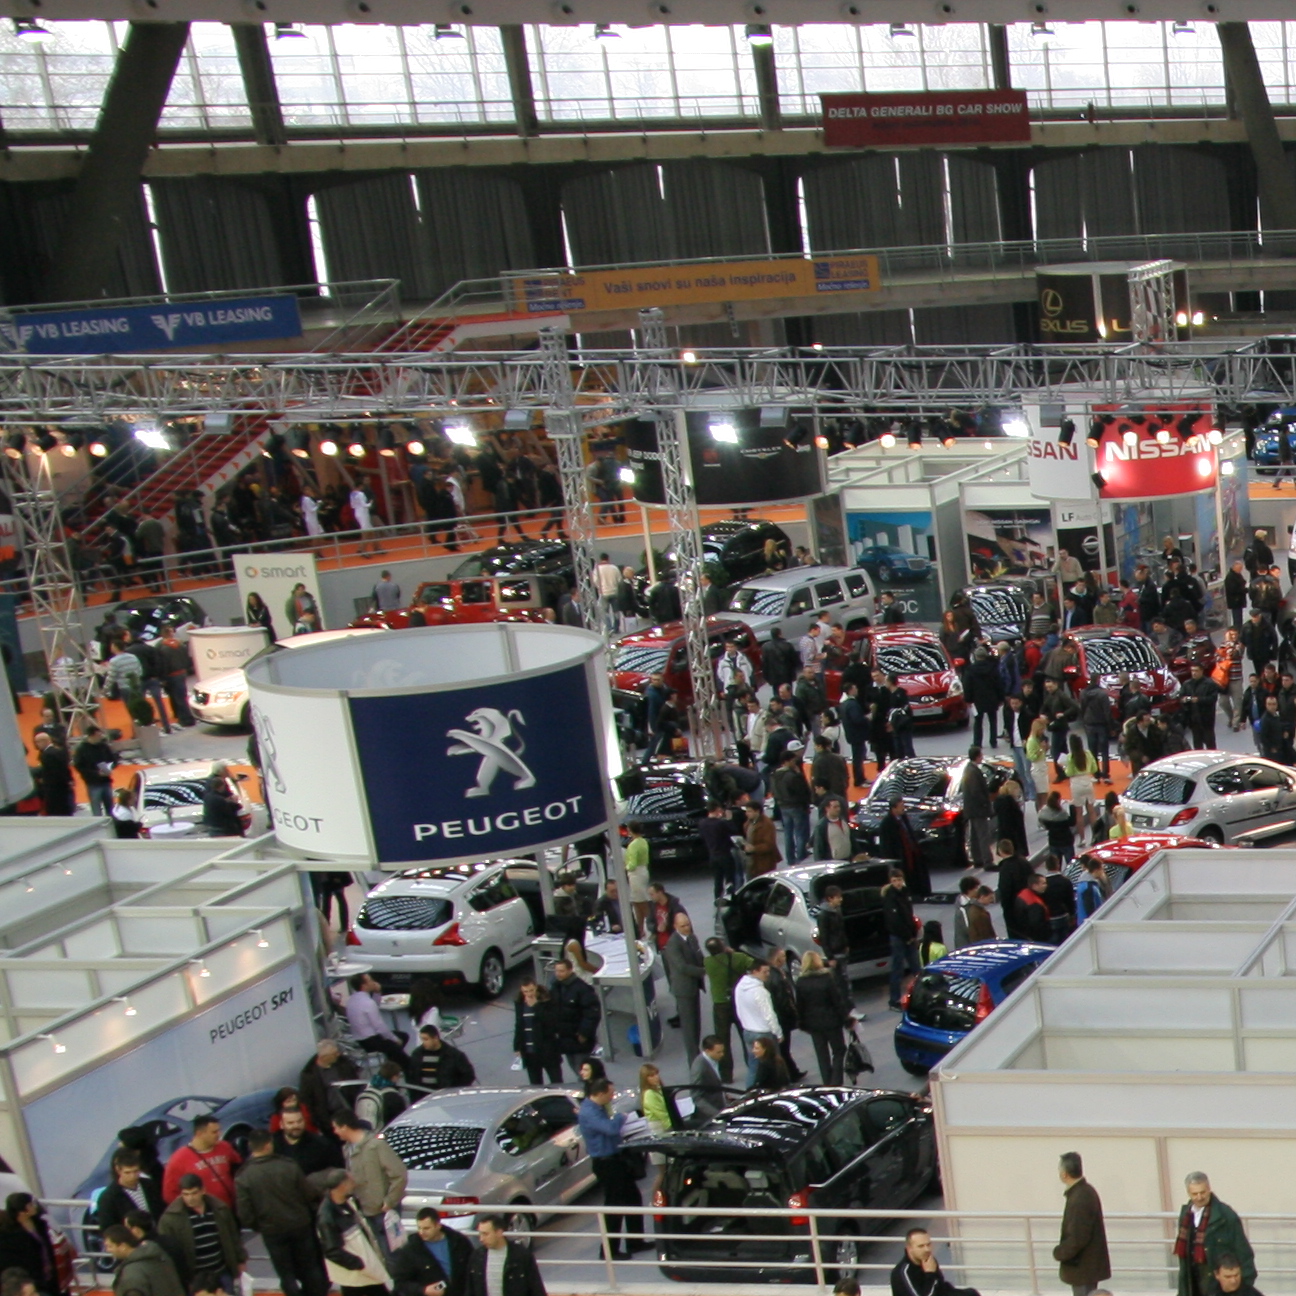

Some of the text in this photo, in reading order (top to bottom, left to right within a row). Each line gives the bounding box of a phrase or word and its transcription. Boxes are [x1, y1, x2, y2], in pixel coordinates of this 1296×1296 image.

[828, 103, 1023, 118] DELTA GENERALI BG CAR SHOW
[604, 281, 632, 294] Vaši
[637, 280, 671, 292] snovi
[676, 280, 691, 289] su
[695, 275, 726, 287] naša
[182, 306, 273, 327] VB LEASING
[1040, 320, 1089, 333] EXUS
[35, 317, 130, 339] VB LEASING
[1105, 432, 1212, 462] NISSAN
[260, 565, 307, 579] smart
[218, 648, 250, 659] smart
[274, 807, 324, 834] GEOT
[413, 795, 584, 842] PEUGEOT
[209, 986, 294, 1045] PEUGEOT SR1
